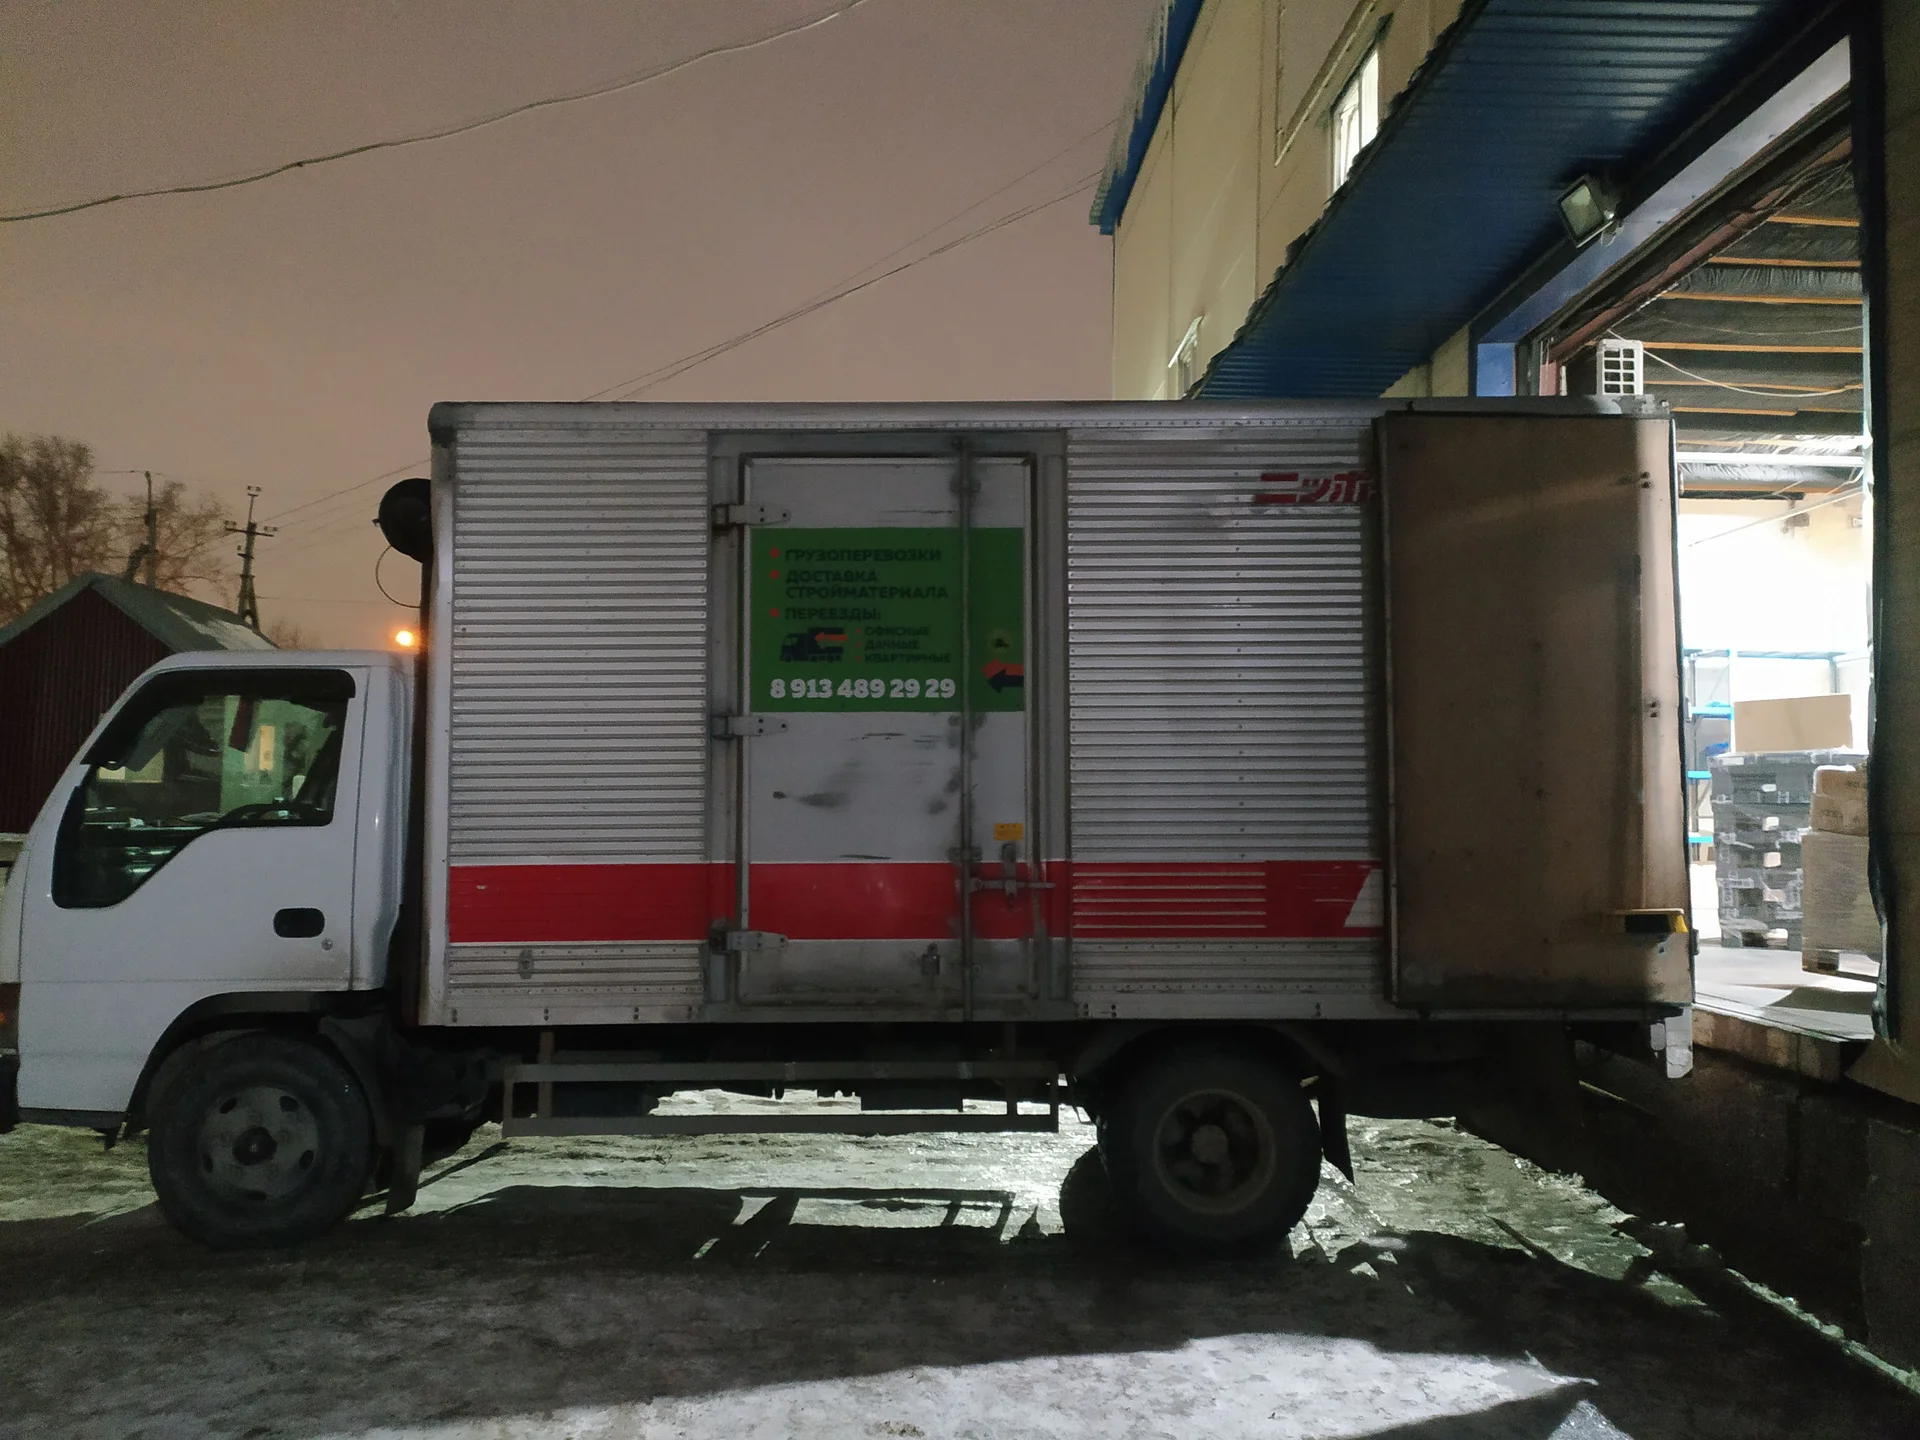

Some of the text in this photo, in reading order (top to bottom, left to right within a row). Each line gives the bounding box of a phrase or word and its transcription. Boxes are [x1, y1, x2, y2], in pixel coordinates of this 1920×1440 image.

[784, 549, 942, 562] ГРУЗОПЕРЕВОЗКИ
[785, 570, 878, 584] ДОСТАВКА
[785, 585, 949, 599] СТРОЙМАТЕРИАЛА
[784, 607, 882, 621] ПЕРЕЕЗДЫ:
[770, 678, 956, 698] 8 913 489 29 29
